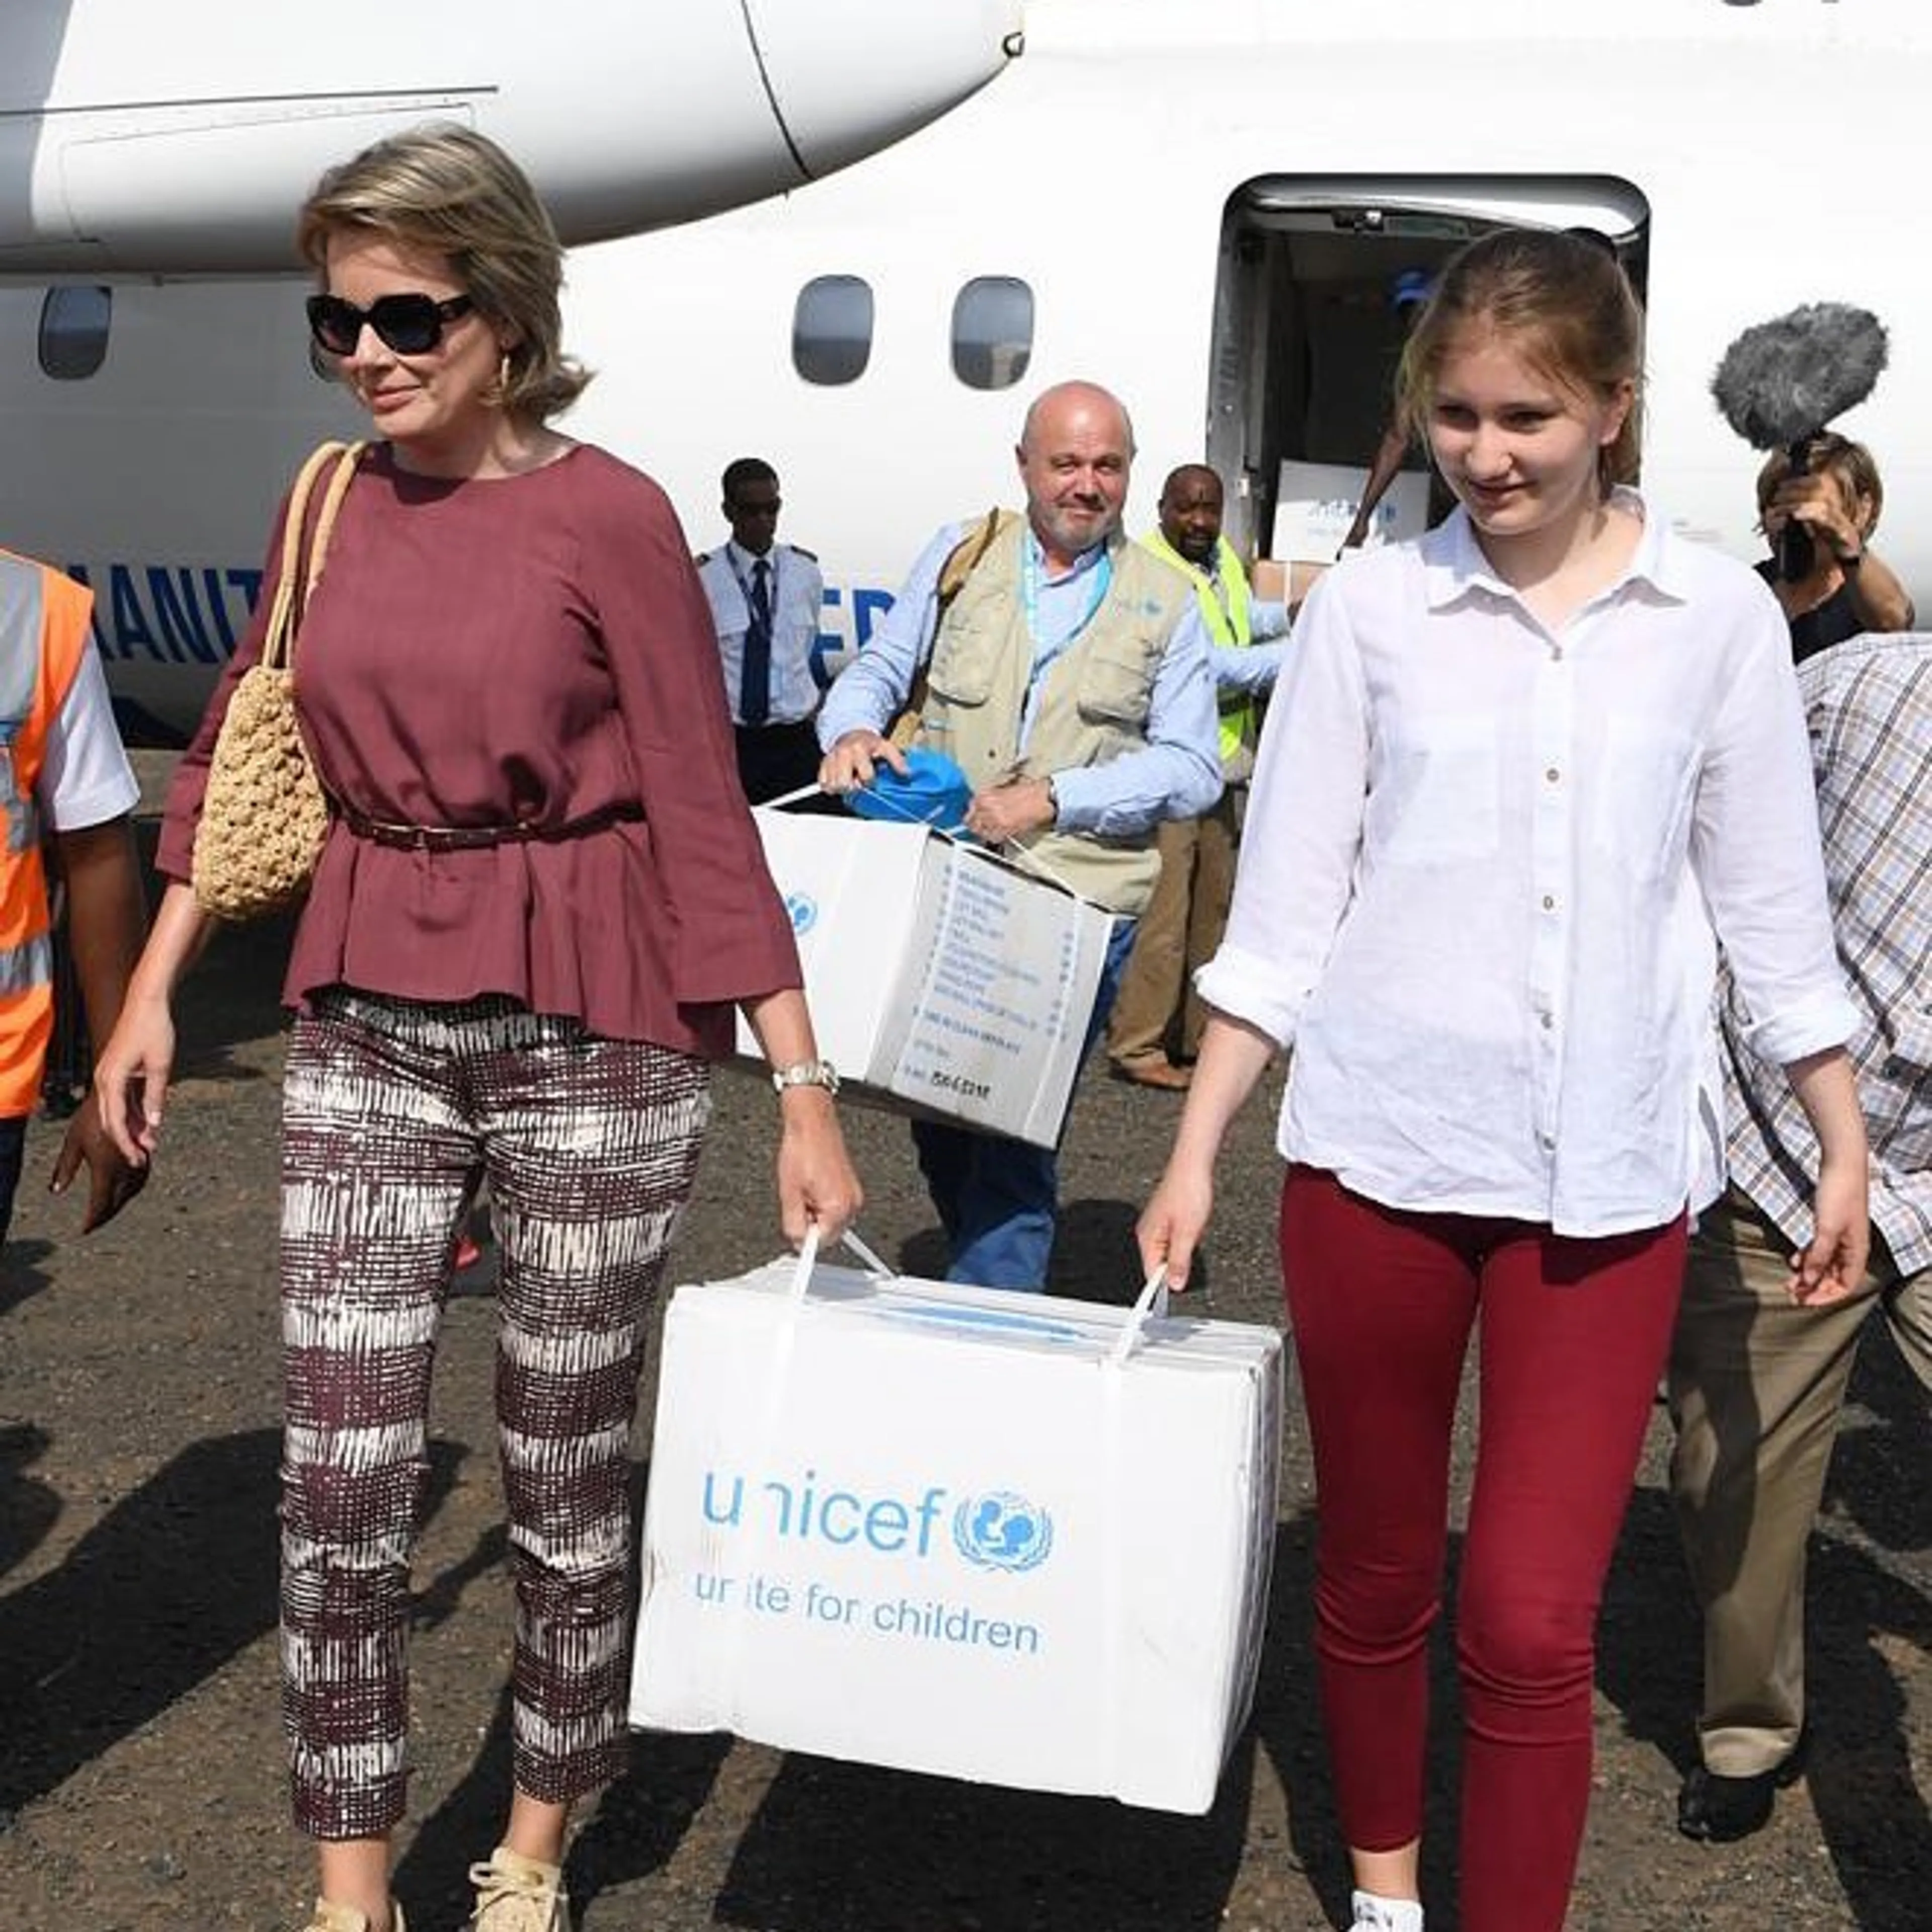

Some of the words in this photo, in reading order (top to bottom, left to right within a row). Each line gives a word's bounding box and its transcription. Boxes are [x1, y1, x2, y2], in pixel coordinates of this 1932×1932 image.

[703, 1470, 947, 1558] unicef
[807, 1583, 860, 1625] for
[873, 1598, 1038, 1655] children
